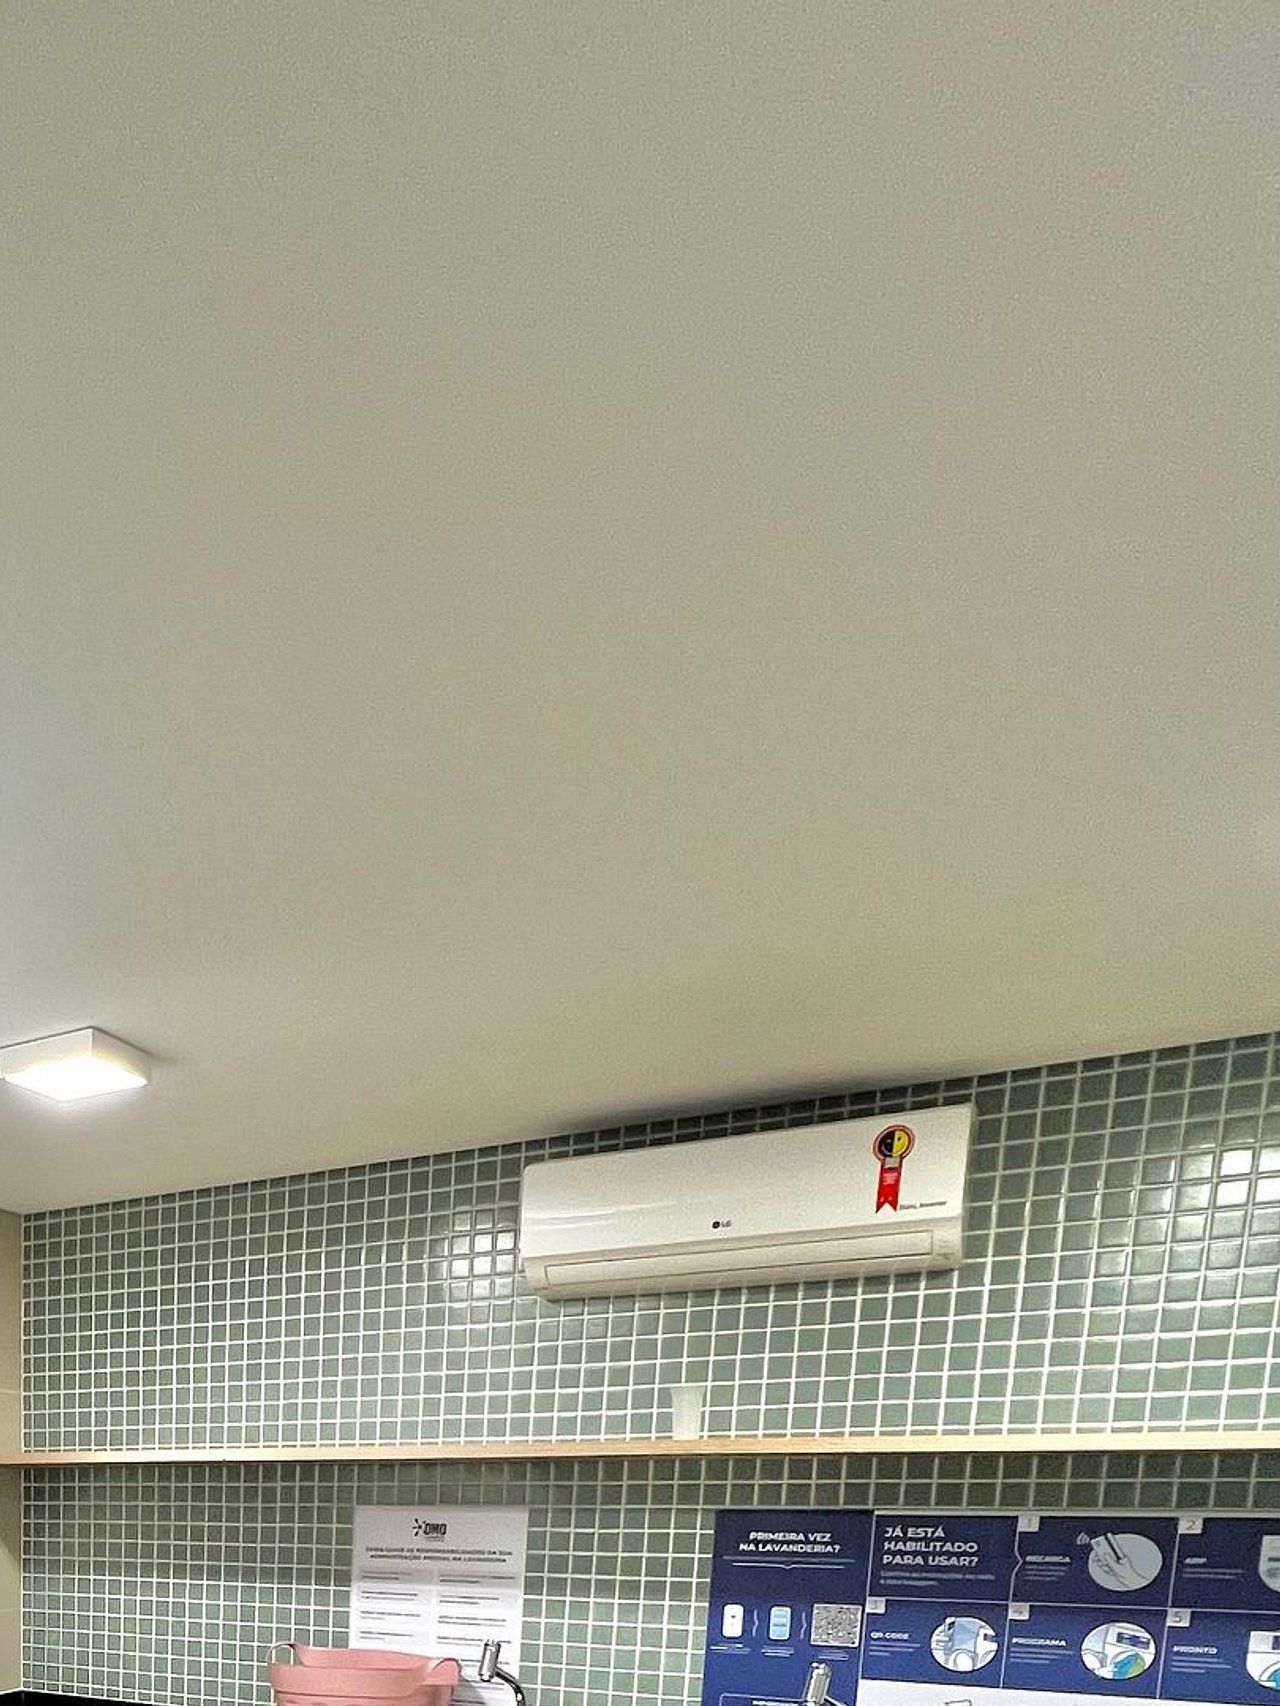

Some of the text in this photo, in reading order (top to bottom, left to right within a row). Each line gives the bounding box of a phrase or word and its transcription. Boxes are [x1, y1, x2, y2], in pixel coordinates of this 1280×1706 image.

[423, 1523, 447, 1536] OMO
[883, 1524, 946, 1538] JÁ ESTÁ
[749, 1531, 832, 1542] PRIMEIRA VEZ
[739, 1543, 841, 1553] NA LAVANDERIA?
[883, 1540, 978, 1553] HABILITADO
[883, 1554, 979, 1567] PARA USAR?
[1012, 1636, 1067, 1647] PROGRAMA
[1172, 1645, 1218, 1655] PRONTO
